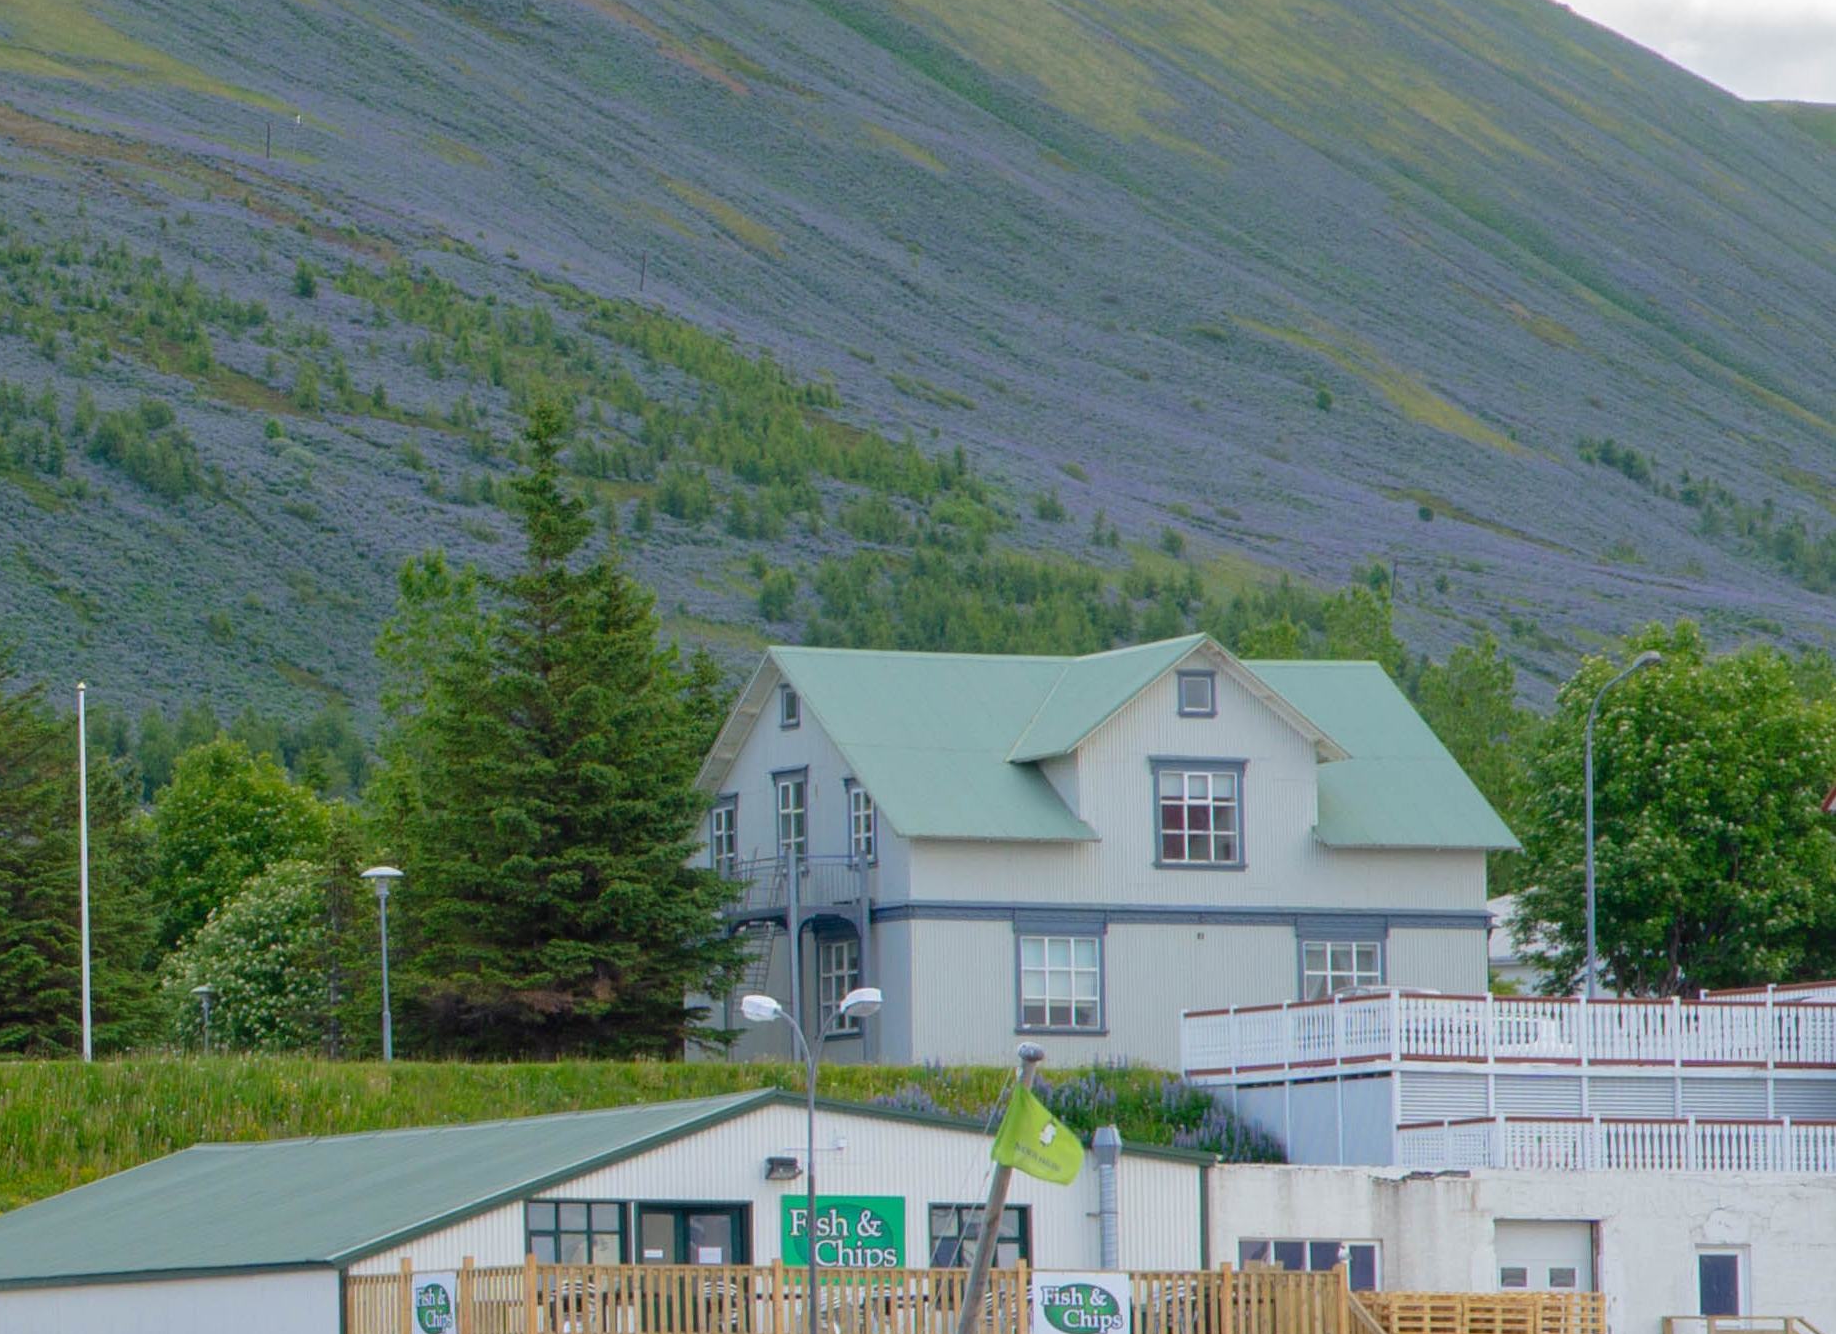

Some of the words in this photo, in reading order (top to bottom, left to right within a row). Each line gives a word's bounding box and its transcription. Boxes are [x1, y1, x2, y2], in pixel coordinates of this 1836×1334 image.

[790, 1208, 850, 1237] Fsh
[856, 1209, 882, 1237] &
[815, 1239, 898, 1267] Chips
[1041, 1285, 1084, 1307] Fish
[1089, 1287, 1107, 1307] &
[1063, 1308, 1123, 1334] Chips
